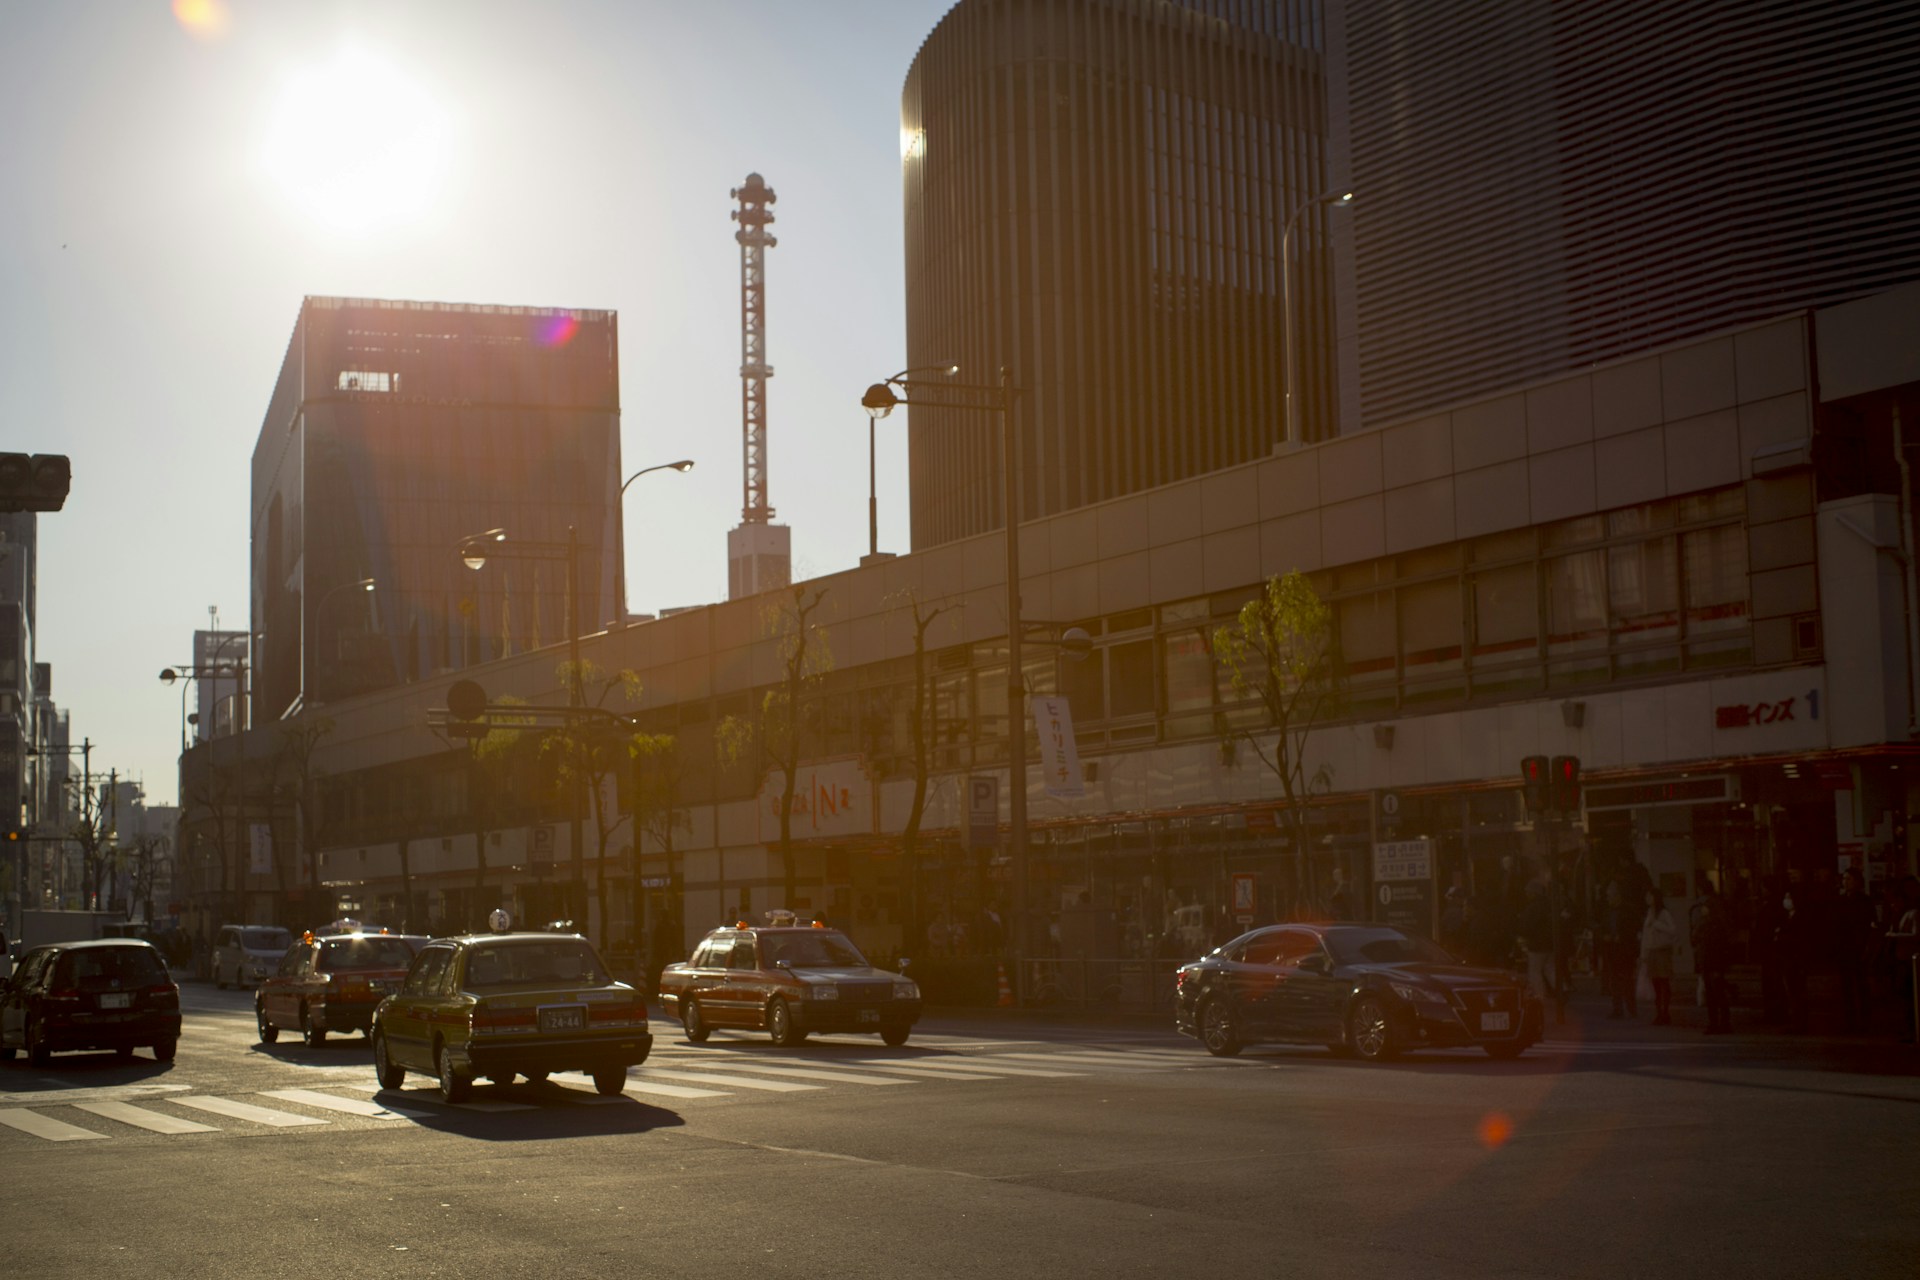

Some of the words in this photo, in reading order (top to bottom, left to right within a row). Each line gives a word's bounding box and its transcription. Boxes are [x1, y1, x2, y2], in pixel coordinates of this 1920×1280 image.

[411, 393, 473, 407] PLAZA
[1046, 702, 1070, 783] ヒカリミチ
[974, 782, 991, 808] P
[534, 830, 548, 849] P
[551, 1018, 580, 1028] 24-44
